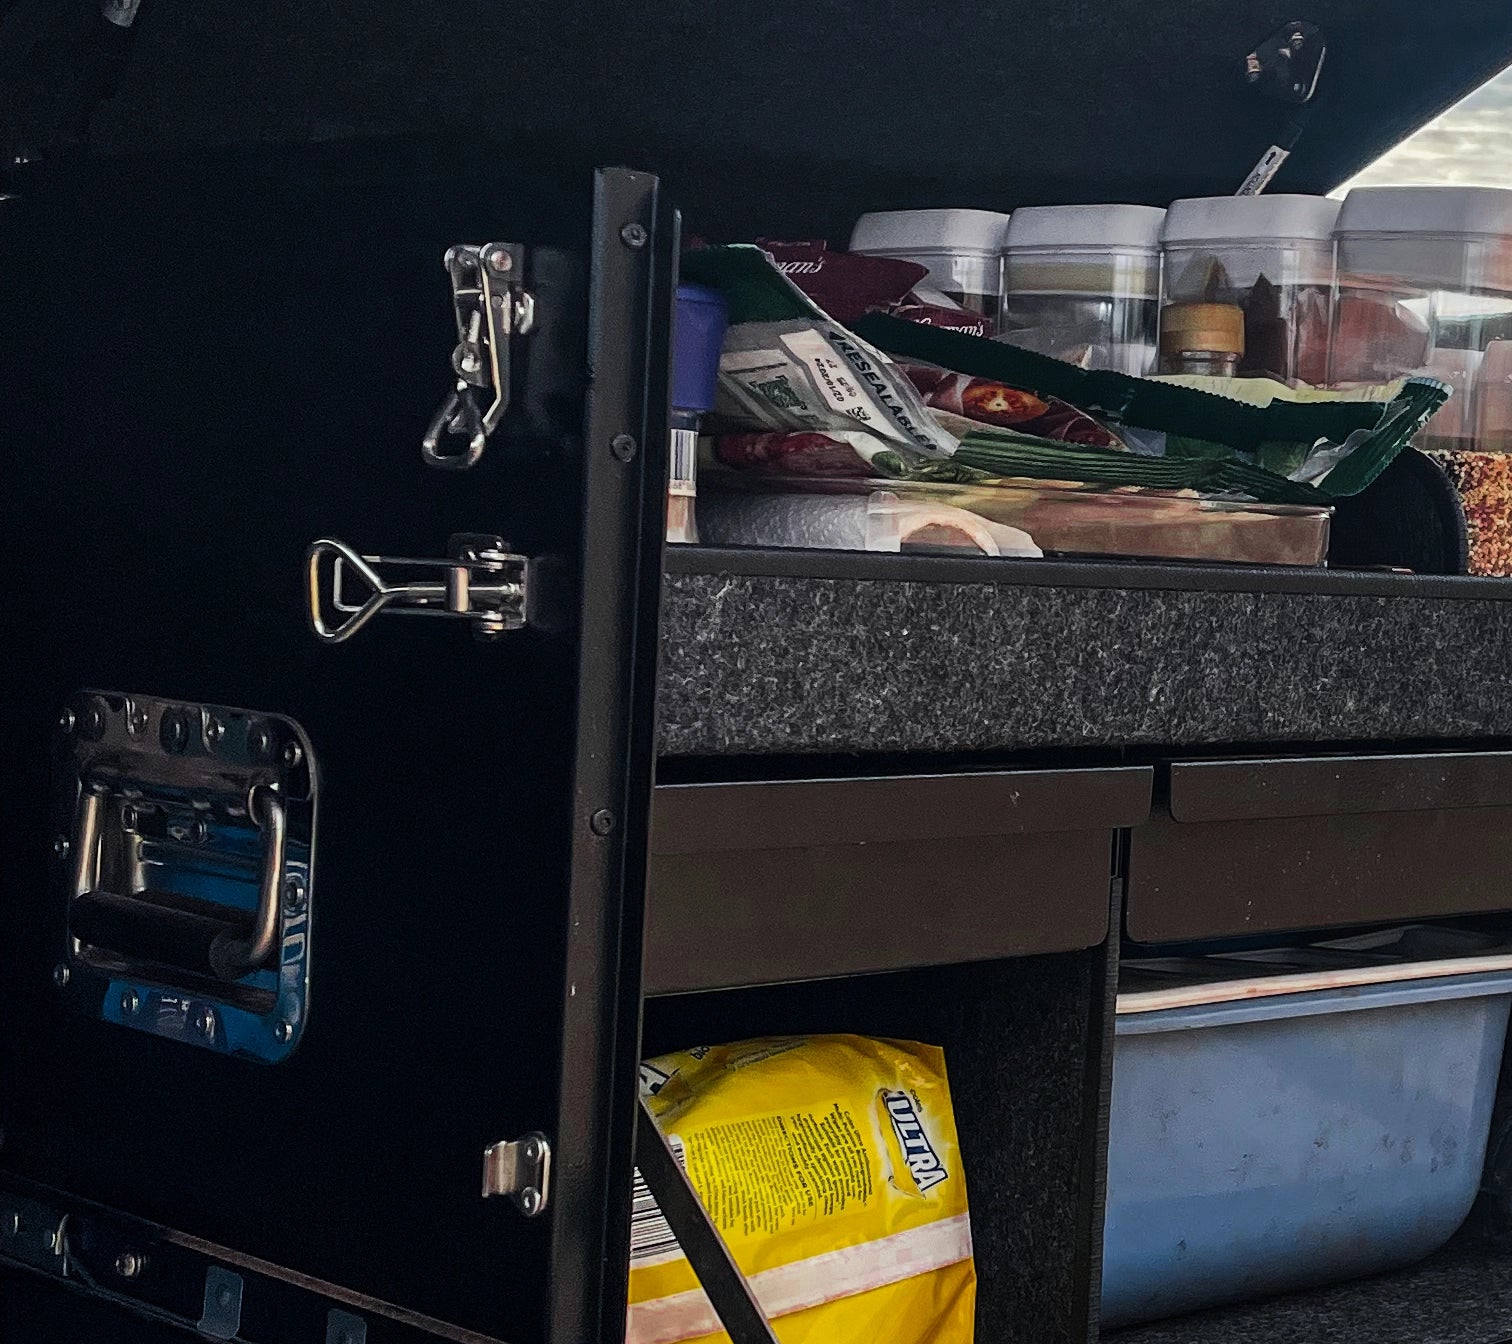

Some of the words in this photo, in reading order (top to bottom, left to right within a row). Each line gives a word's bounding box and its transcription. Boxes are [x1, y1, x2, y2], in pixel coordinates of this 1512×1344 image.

[839, 338, 927, 446] RESEALABLE
[796, 1170, 807, 1187] FOR
[805, 1189, 813, 1206] USE
[886, 1096, 948, 1191] ULTRA
